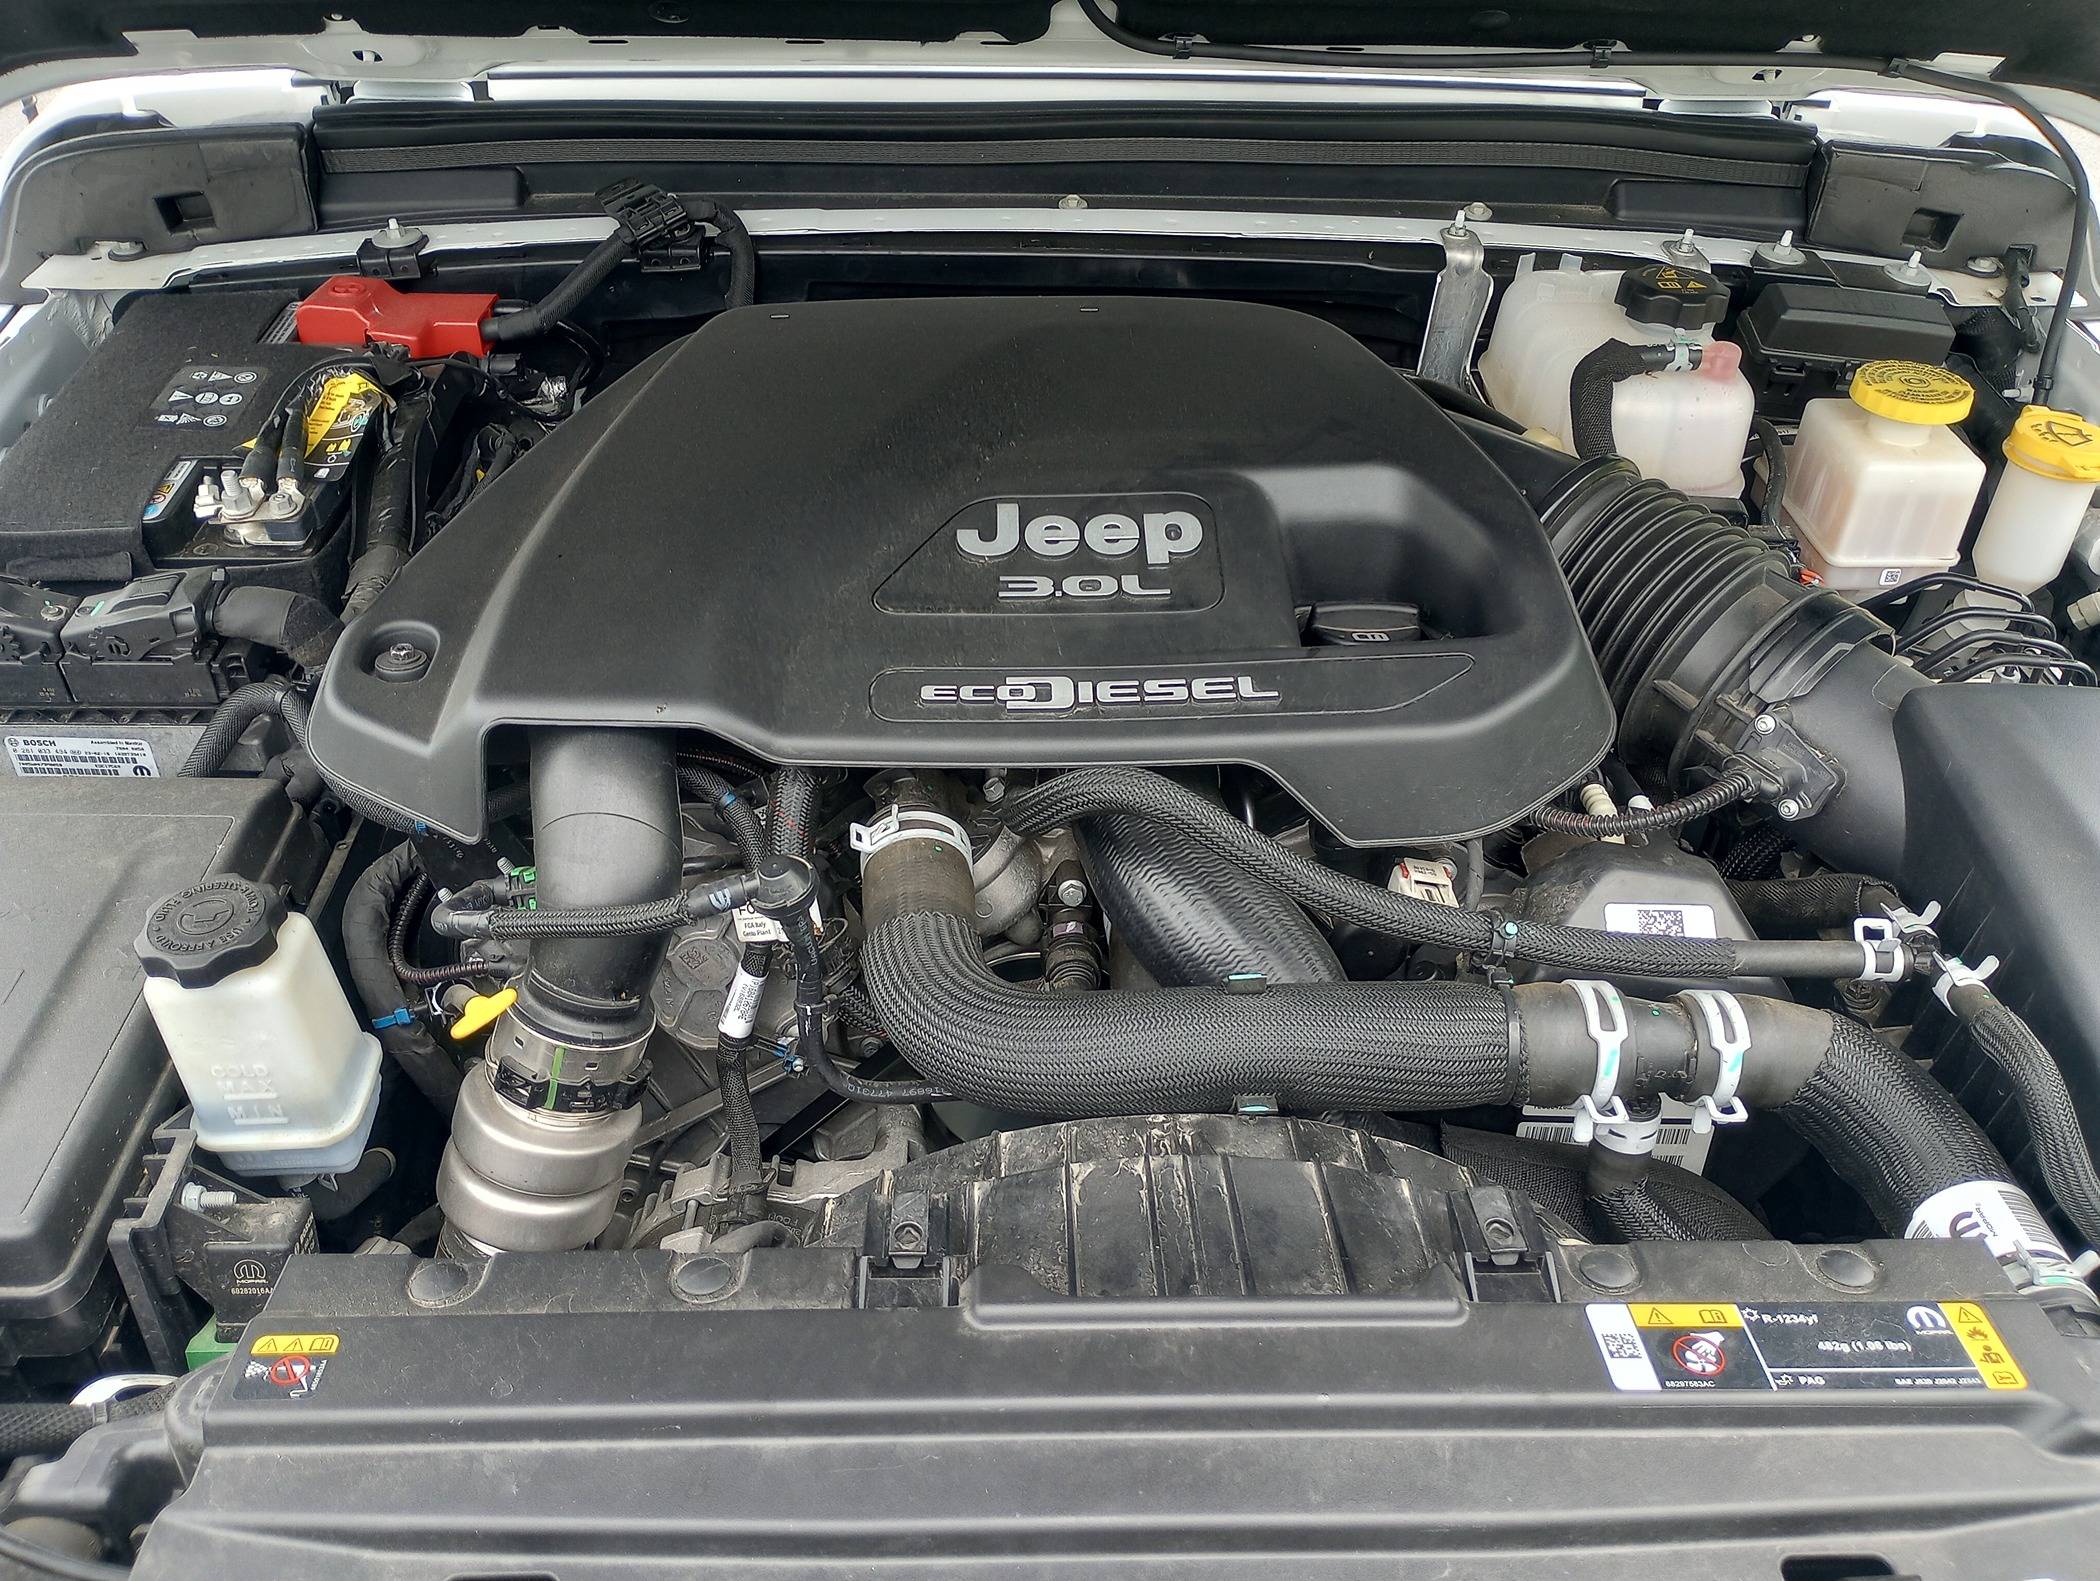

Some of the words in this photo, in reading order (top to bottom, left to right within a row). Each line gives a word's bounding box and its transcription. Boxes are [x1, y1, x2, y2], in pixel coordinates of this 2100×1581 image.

[956, 503, 1203, 566] Jeep
[998, 574, 1171, 597] 3.0L
[23, 739, 56, 747] BOSCH
[220, 927, 244, 945] USE
[209, 1064, 269, 1078] COLD
[217, 1080, 272, 1093] MAX
[227, 1104, 285, 1119] MIN
[1761, 1313, 1818, 1326] R-1234yf
[1797, 1376, 1826, 1386] PAG
